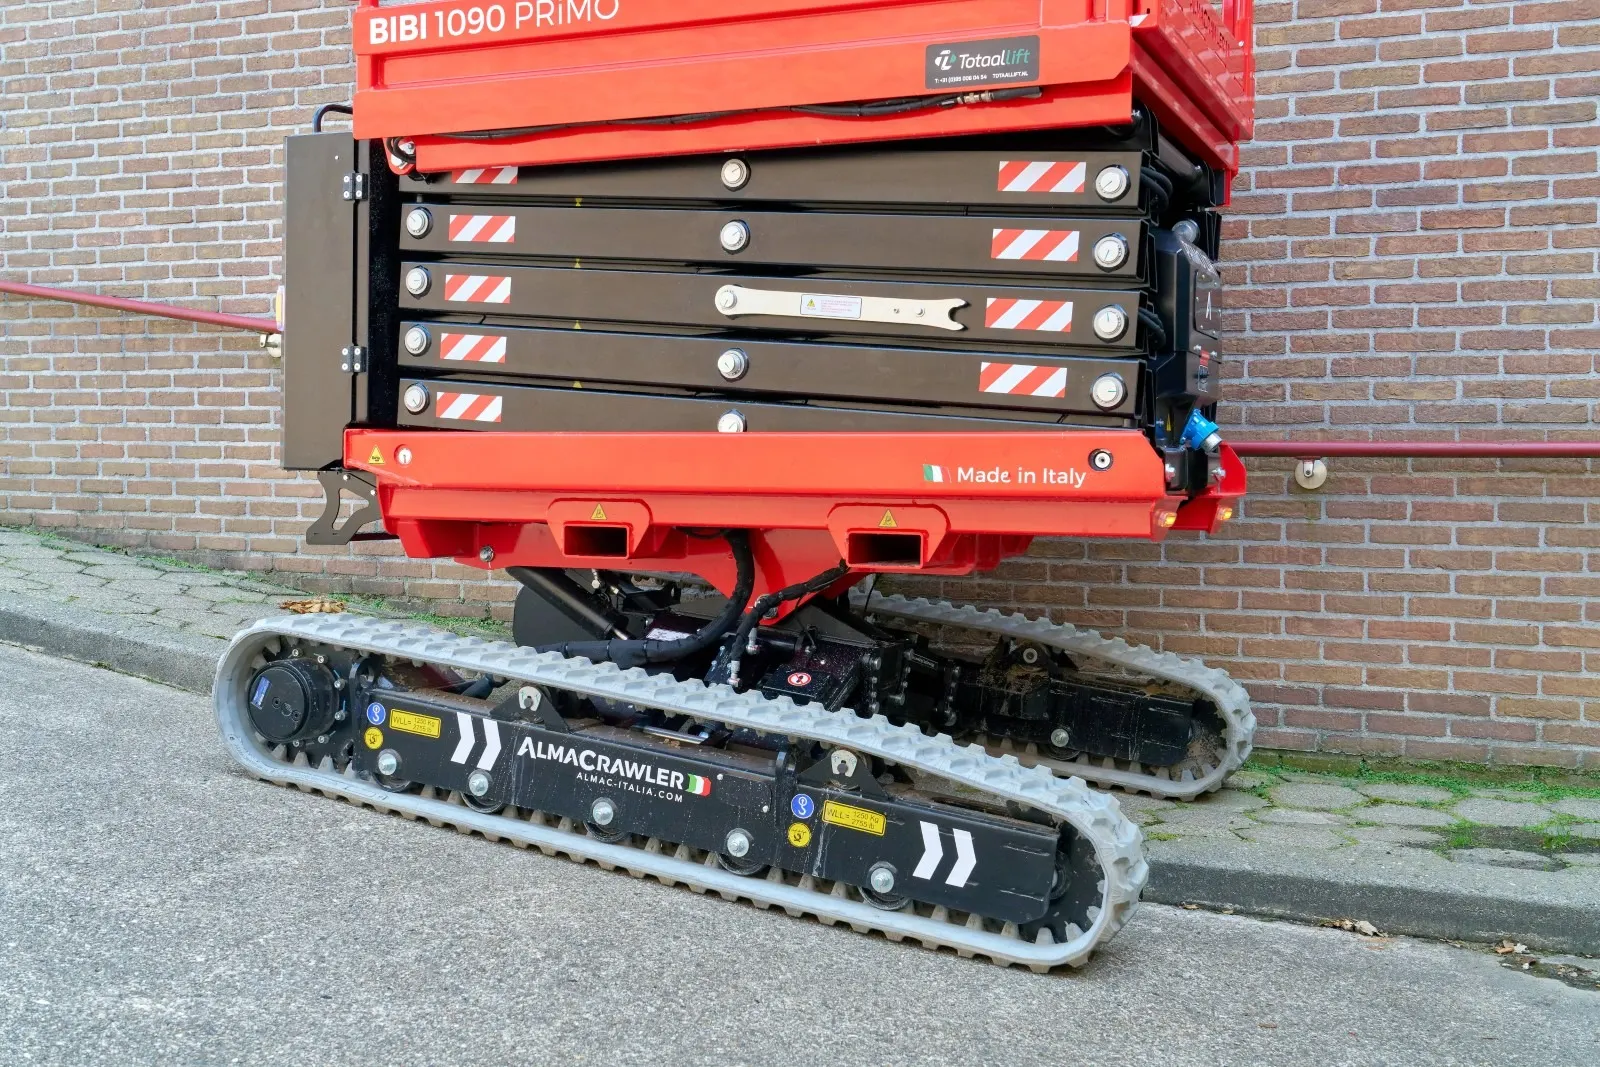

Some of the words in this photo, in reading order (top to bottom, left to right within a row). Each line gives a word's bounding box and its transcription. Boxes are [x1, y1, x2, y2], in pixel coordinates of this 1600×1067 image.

[369, 11, 427, 45] BIBI
[434, 4, 506, 38] 1090
[959, 48, 1031, 70] Totaallift
[957, 466, 1011, 484] Made
[1018, 467, 1036, 484] in
[1042, 467, 1087, 489] Italy
[517, 736, 685, 790] ALMACRAWLER
[576, 771, 684, 804] ALMAC-ITALIA.COM
